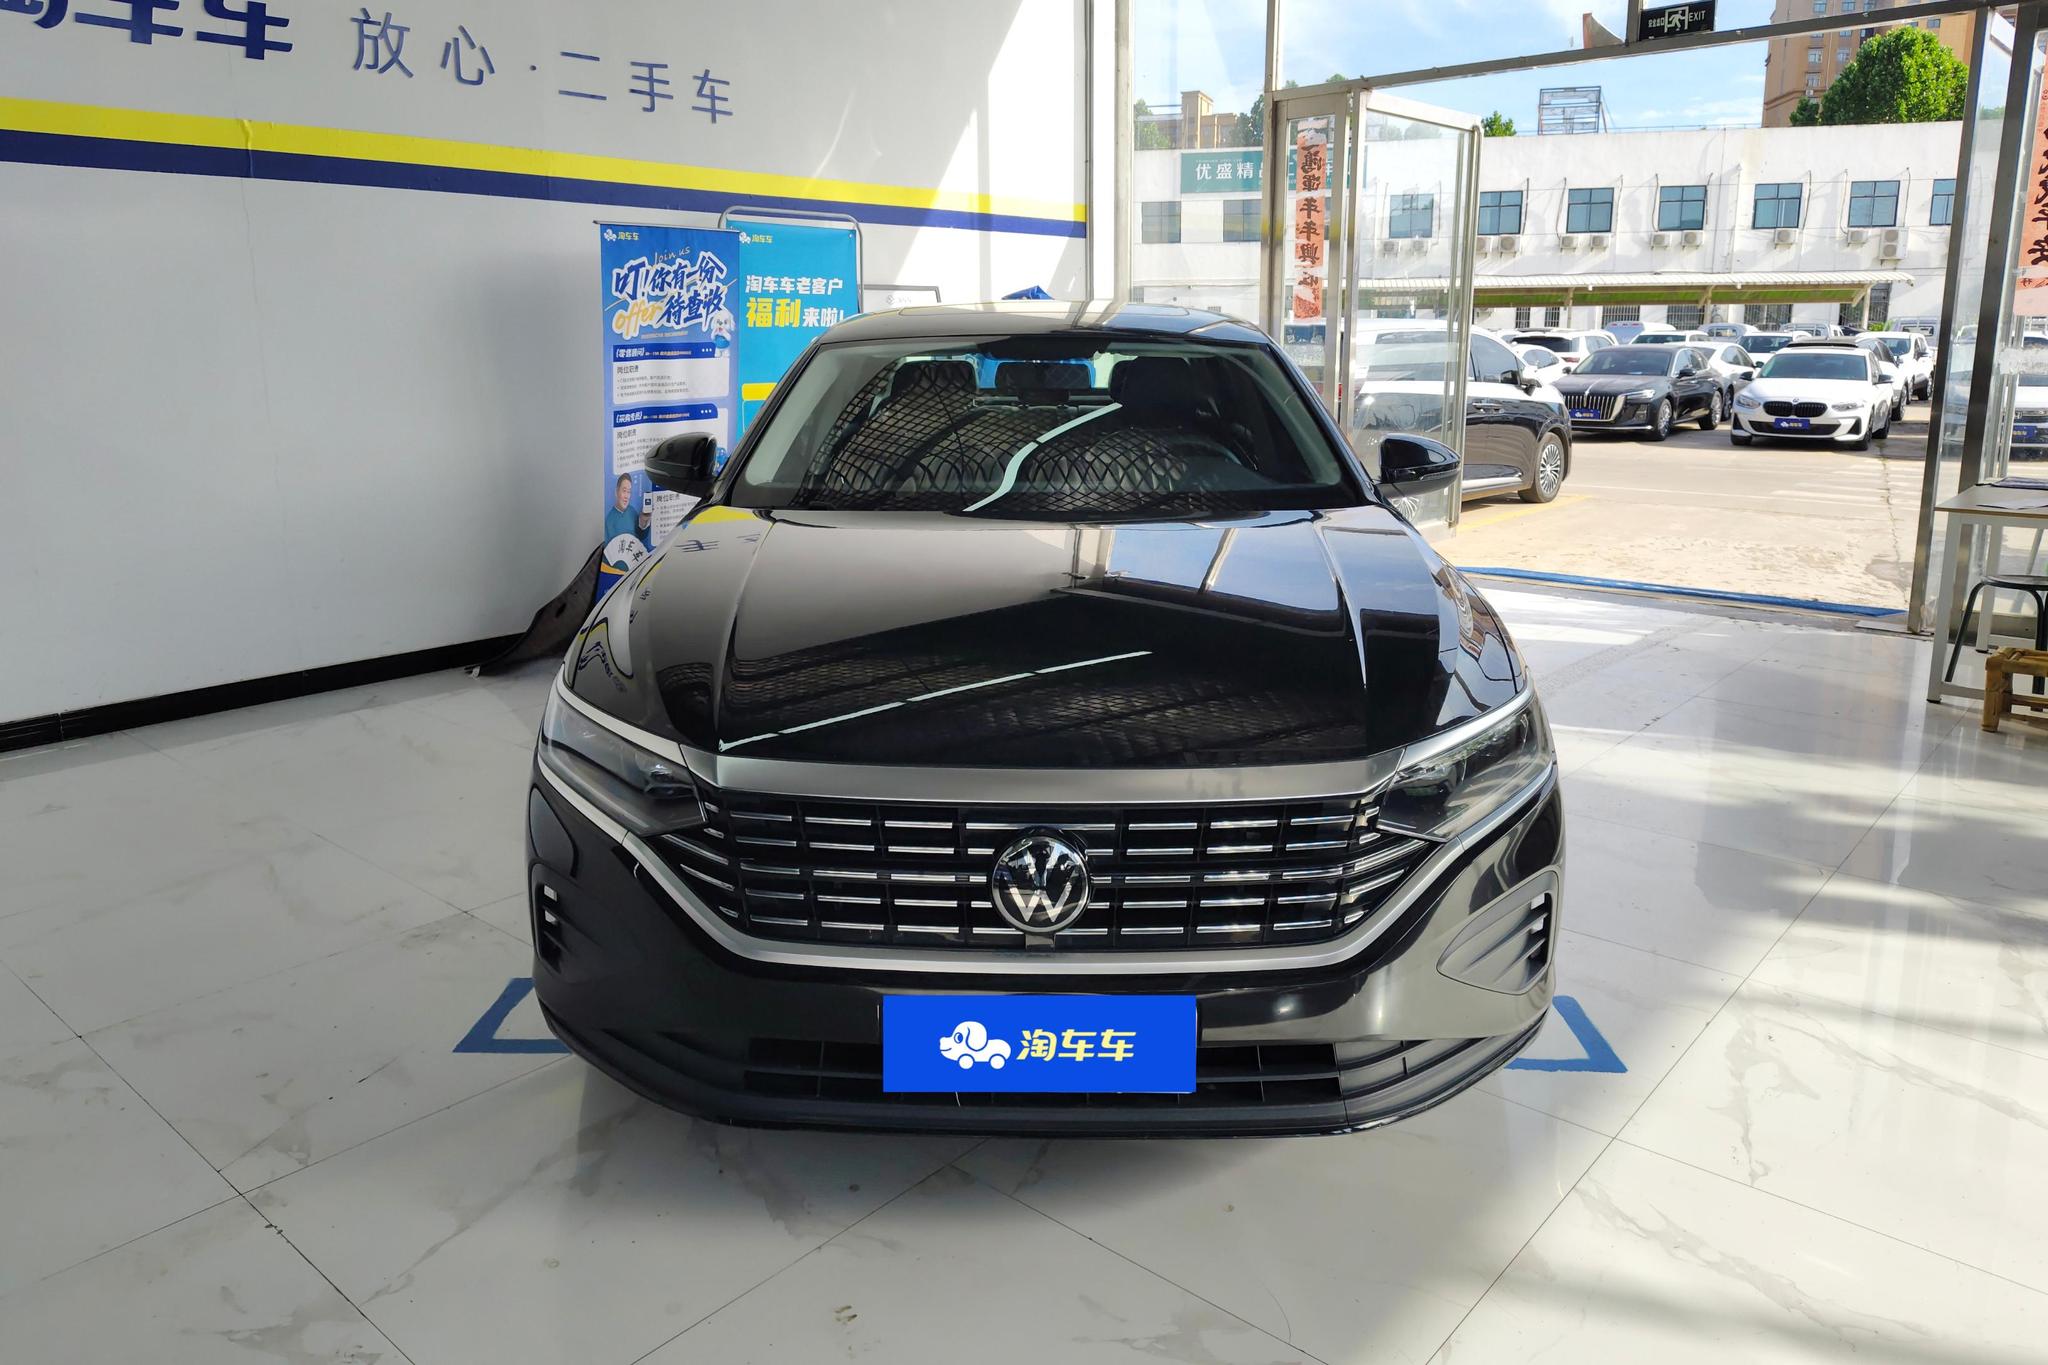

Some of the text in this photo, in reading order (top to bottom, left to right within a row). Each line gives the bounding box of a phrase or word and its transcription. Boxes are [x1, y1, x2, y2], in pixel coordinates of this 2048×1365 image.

[1688, 10, 1706, 22] EXIT
[1195, 162, 1263, 181] 优盛精
[618, 232, 639, 242] 淘车车
[751, 234, 773, 244] 淘车车
[677, 245, 691, 257] us
[745, 275, 844, 296] 淘车车老客户
[614, 300, 663, 335] offer
[1016, 1028, 1137, 1062] 淘车车
